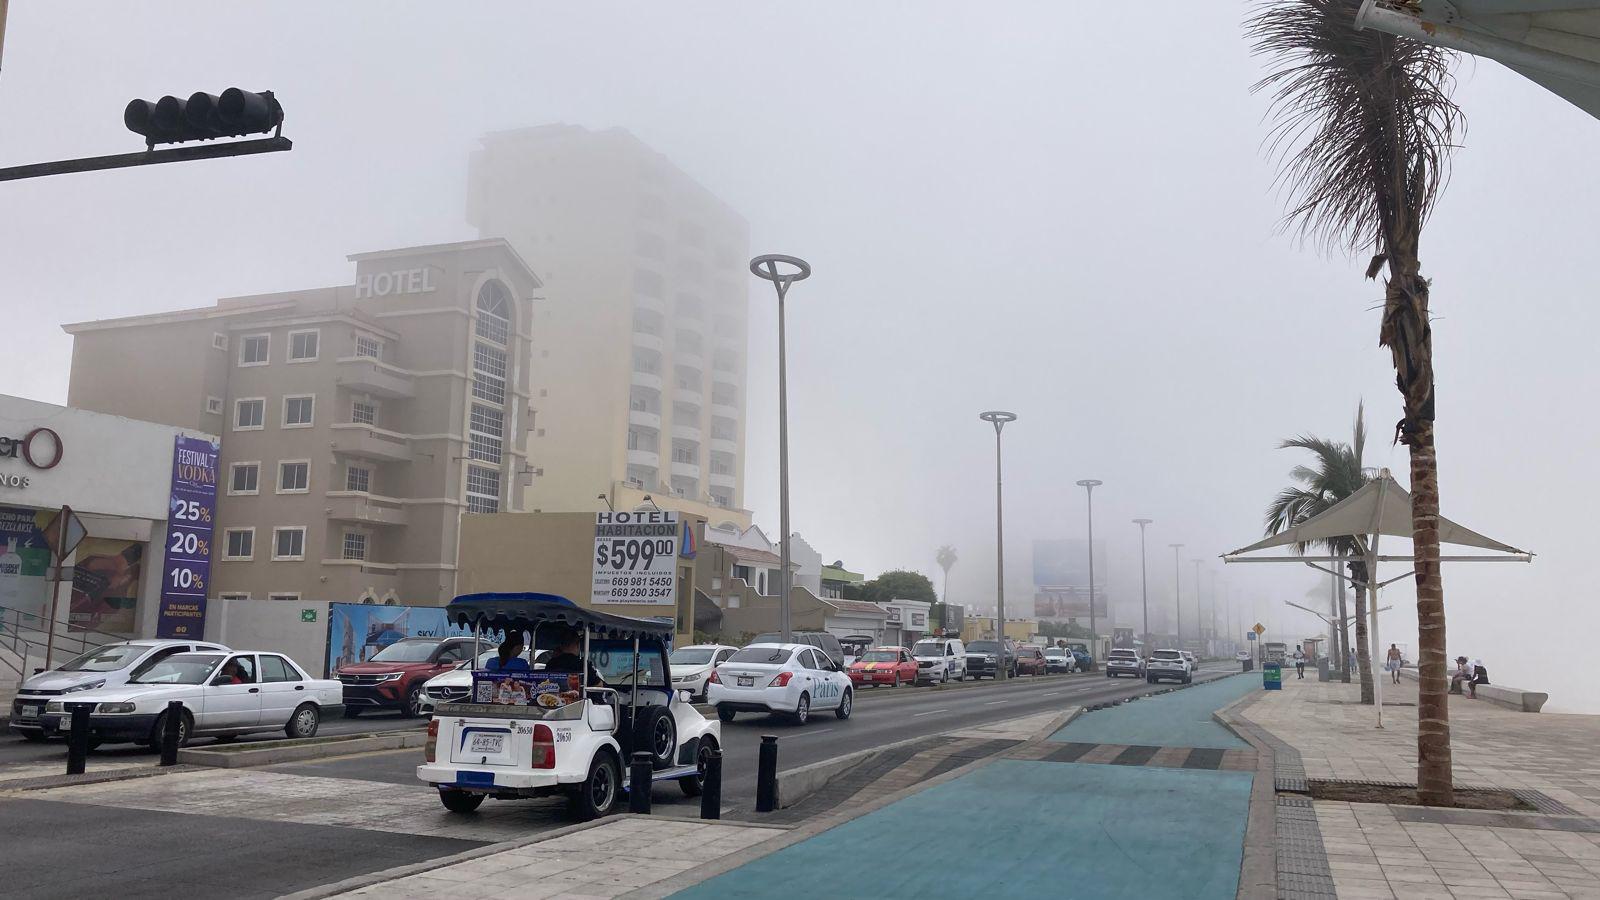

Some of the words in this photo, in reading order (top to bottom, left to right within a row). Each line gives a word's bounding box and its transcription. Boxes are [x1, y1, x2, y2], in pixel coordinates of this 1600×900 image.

[355, 268, 437, 299] HOTEL
[178, 449, 209, 468] FESTIVAL
[178, 464, 215, 483] VODKA
[175, 500, 211, 522] 25%
[598, 512, 675, 524] HOTEL
[597, 525, 675, 537] HABITACION
[170, 532, 209, 555] 20%
[171, 567, 203, 589] 10%
[612, 577, 629, 587] 669
[630, 577, 648, 587] 981
[649, 577, 672, 587] 5450
[611, 587, 629, 598] 669
[630, 588, 648, 597] 290
[648, 588, 672, 598] 3547
[177, 603, 199, 611] MARCAS
[812, 677, 839, 699] Paris
